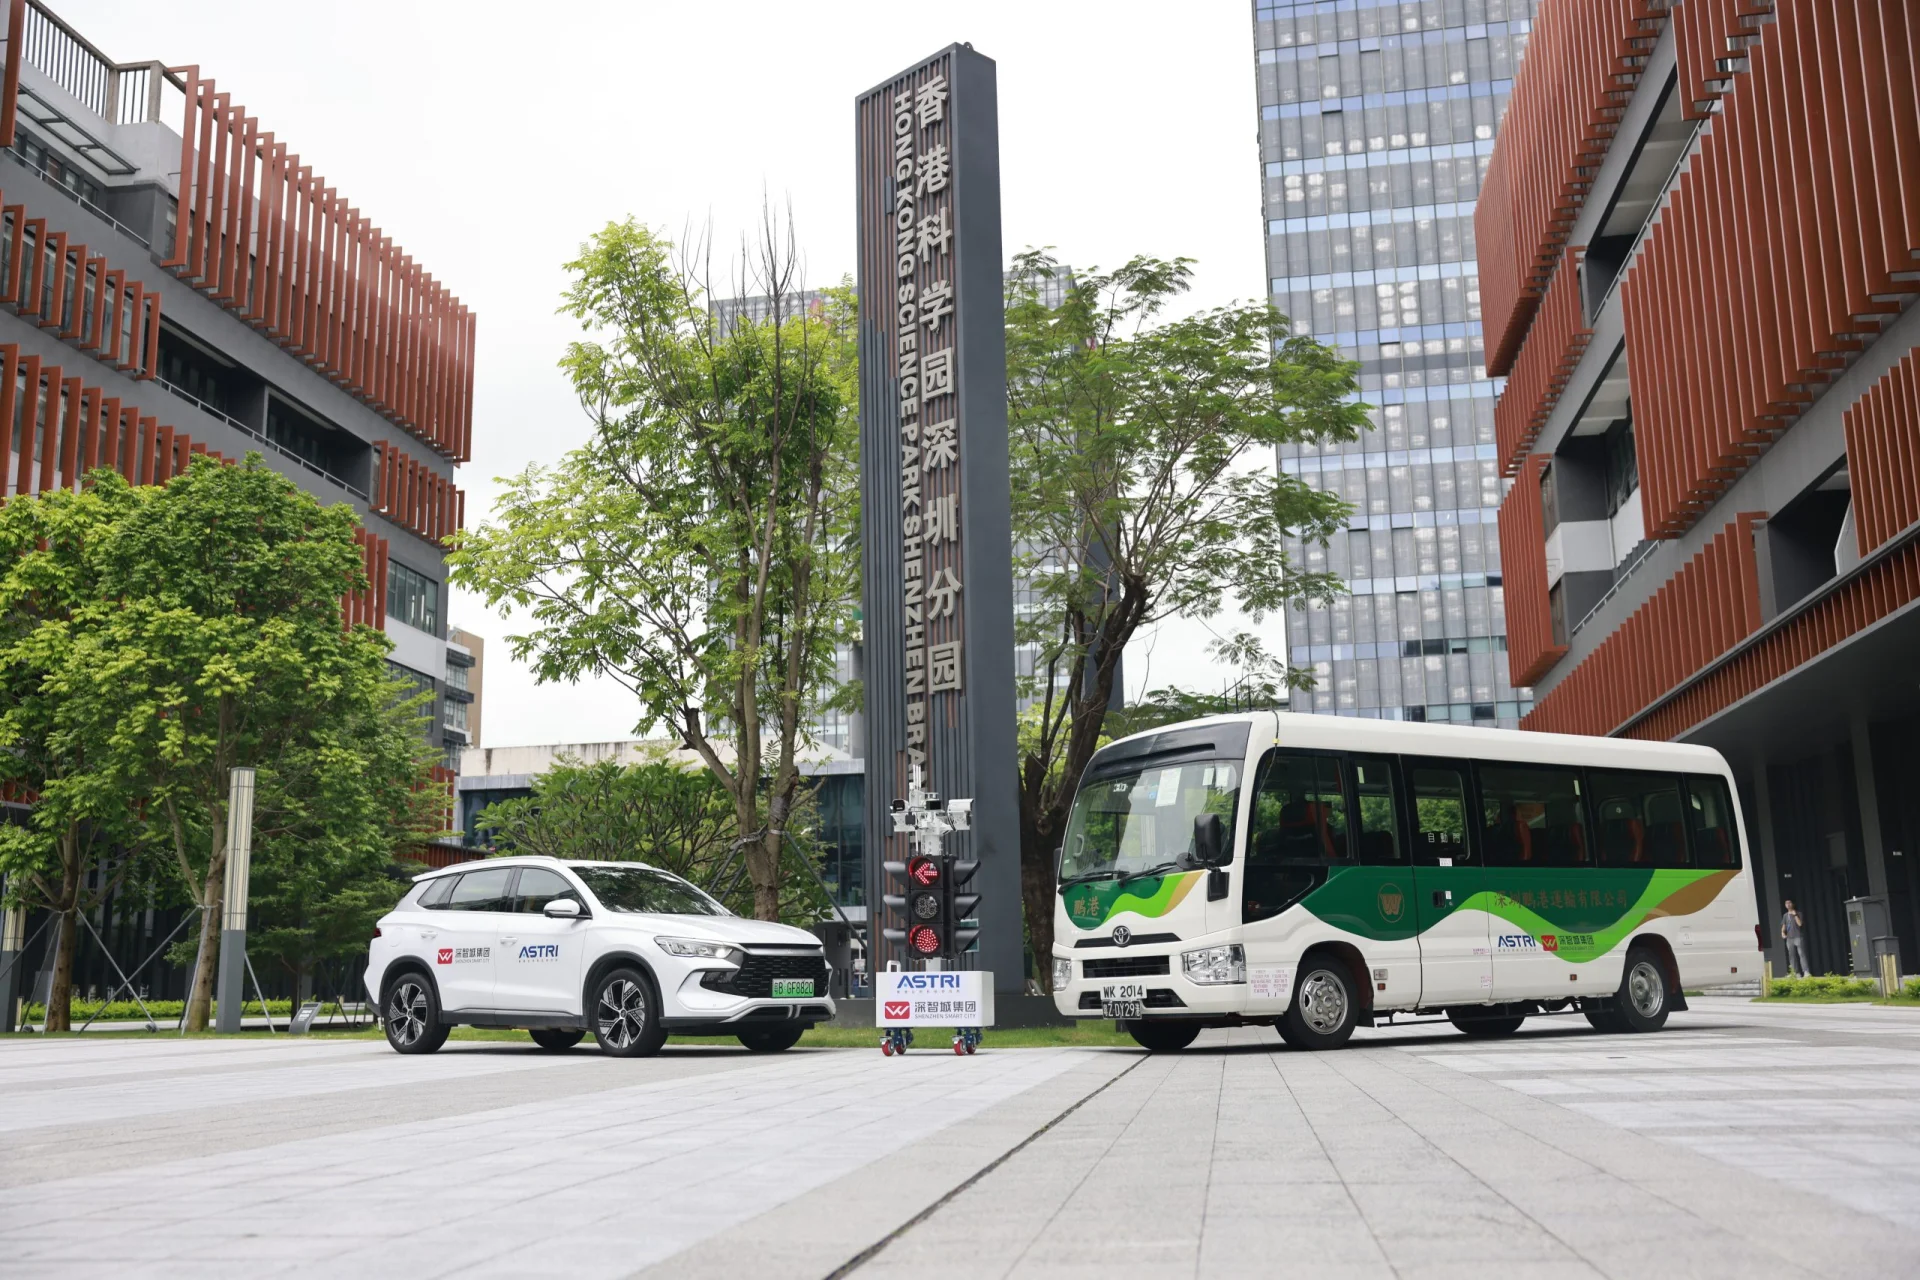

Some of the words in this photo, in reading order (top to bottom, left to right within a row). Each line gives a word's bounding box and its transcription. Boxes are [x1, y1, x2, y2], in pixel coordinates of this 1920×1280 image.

[895, 90, 913, 182] HONG
[896, 185, 915, 278] KONG
[898, 283, 918, 418] SCIENCE
[914, 75, 962, 695] 香港科学园深圳分园
[901, 422, 920, 511] PARK
[904, 515, 924, 695] SHENZHEN
[519, 945, 559, 959] ASTRI
[897, 974, 960, 989] ASTRI
[1498, 935, 1536, 948] ASTRI
[915, 1000, 976, 1013] 深智城集团
[1103, 985, 1116, 998] WK
[1119, 985, 1143, 998] 2014
